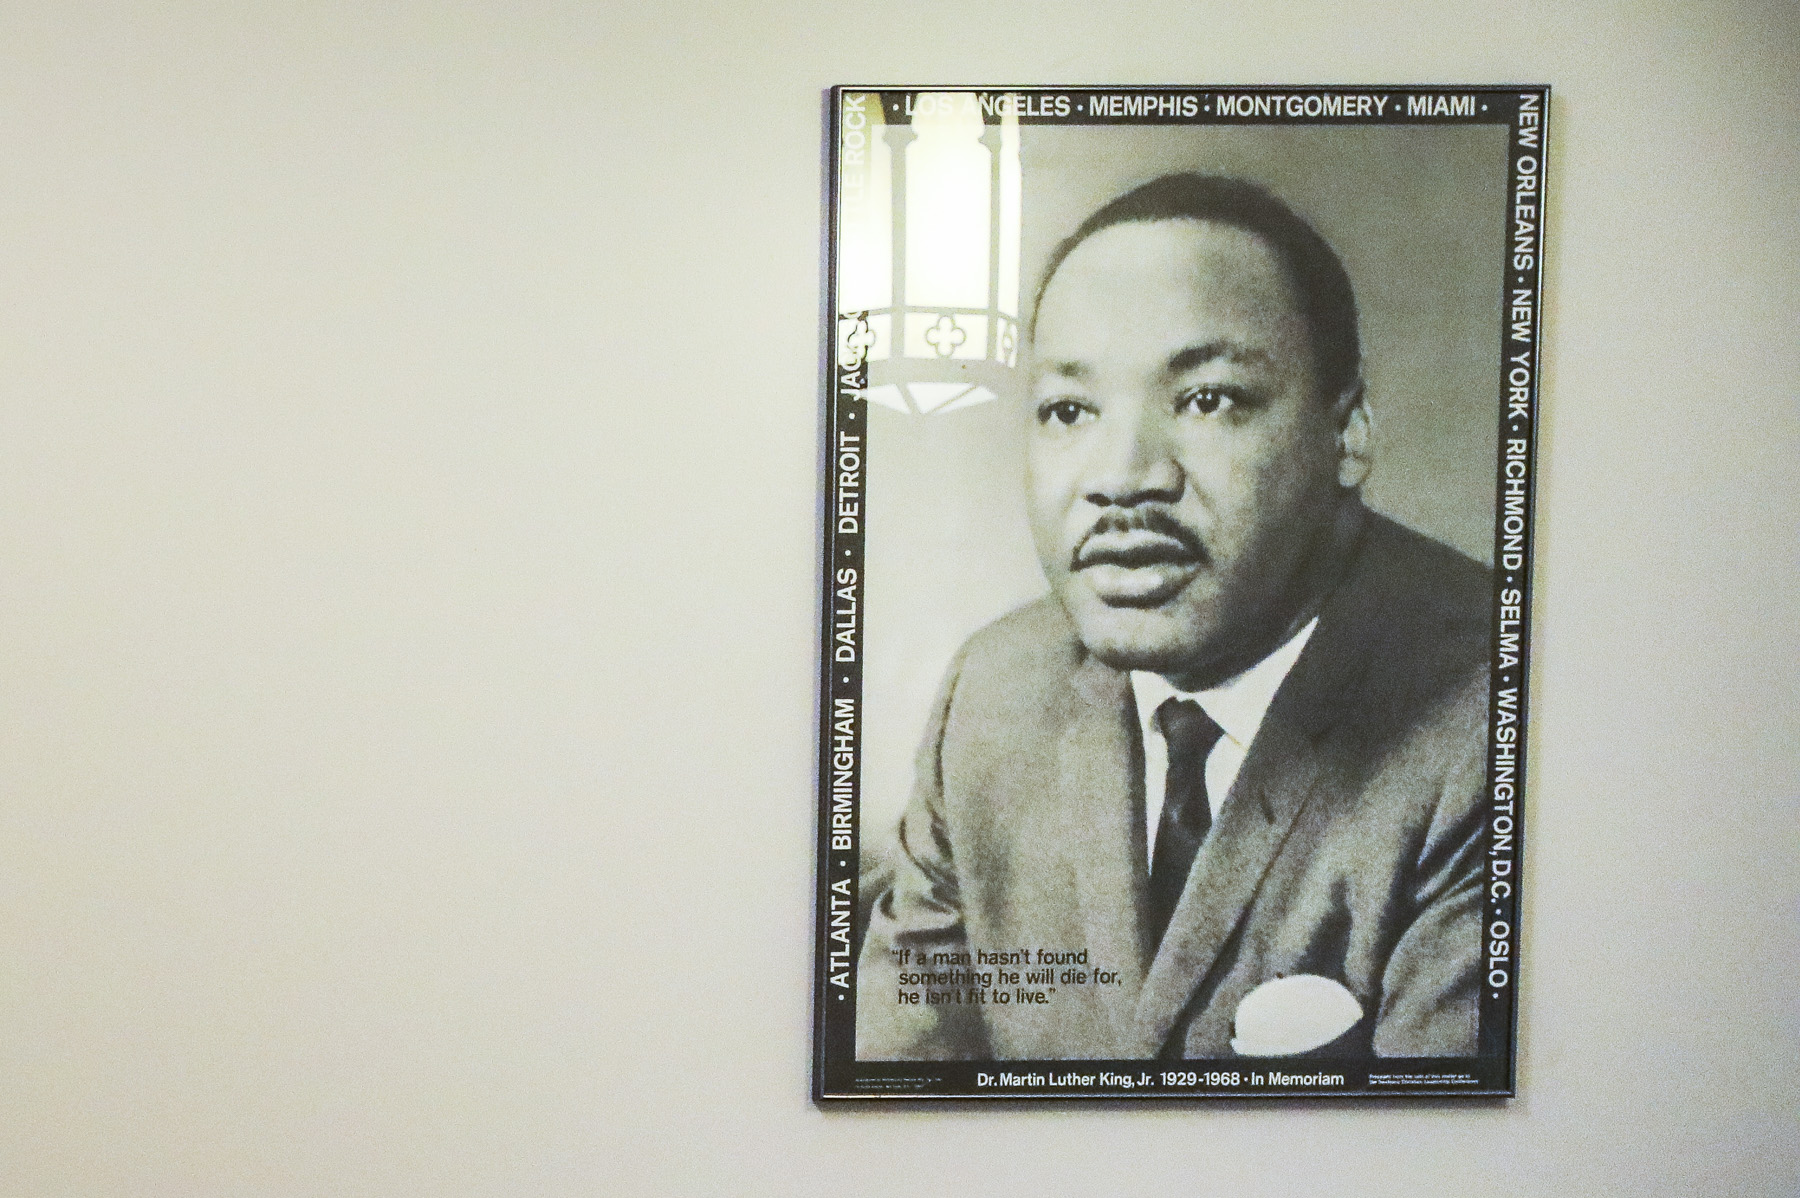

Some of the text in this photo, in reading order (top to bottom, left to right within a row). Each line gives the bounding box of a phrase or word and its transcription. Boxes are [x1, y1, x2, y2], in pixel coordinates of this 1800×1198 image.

[845, 94, 867, 167] ROCK
[905, 94, 1475, 117] LOS ANGELES MEMPHIS MONTGOMERY MIAMI
[1518, 94, 1539, 148] NEW
[1513, 155, 1537, 271] ORLEANS
[1511, 288, 1533, 343] NEW
[1508, 351, 1530, 420] YORK
[838, 430, 861, 534] DETROIT
[1502, 438, 1527, 571] RICHMOND
[835, 567, 858, 663] DALLAS
[1498, 588, 1521, 670] SELMA
[832, 698, 855, 850] BIRMINGHAM
[830, 878, 852, 989] ATLANTA
[917, 952, 927, 965] a
[933, 952, 971, 965] man
[977, 948, 1030, 965] hasn't
[1037, 948, 1088, 965] found
[1488, 920, 1511, 988] OSLO
[898, 988, 920, 1005] he
[969, 987, 986, 1005] fit
[993, 988, 1010, 1004] to
[899, 967, 1122, 988] something he will die for,
[977, 1072, 998, 1087] Dr.
[1000, 1072, 1045, 1087] Martin
[1049, 1072, 1096, 1087] Luther
[1099, 1072, 1135, 1089] King,
[1136, 1072, 1155, 1086] Jr.
[1251, 1071, 1264, 1086] In
[1268, 1071, 1345, 1086] Memoriam
